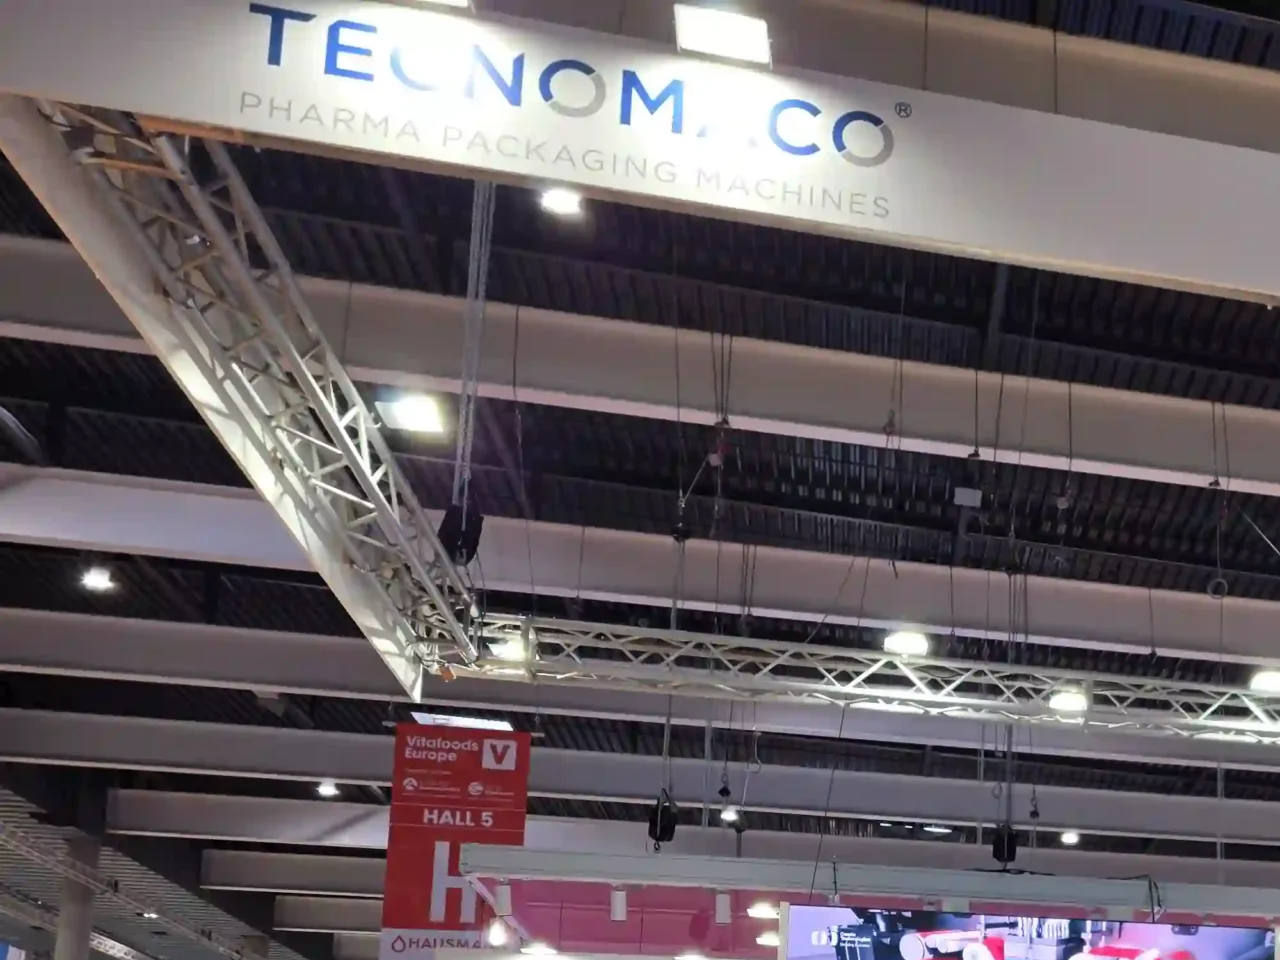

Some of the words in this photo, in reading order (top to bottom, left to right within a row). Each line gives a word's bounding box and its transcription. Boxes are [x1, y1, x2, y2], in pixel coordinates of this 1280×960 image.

[239, 91, 421, 144] PHARMA
[442, 127, 678, 184] PACKAGING
[696, 168, 891, 219] MACHINES
[407, 736, 479, 752] Vitafoods
[405, 747, 457, 762] Europe
[423, 808, 475, 827] HALL
[481, 812, 493, 827] 5
